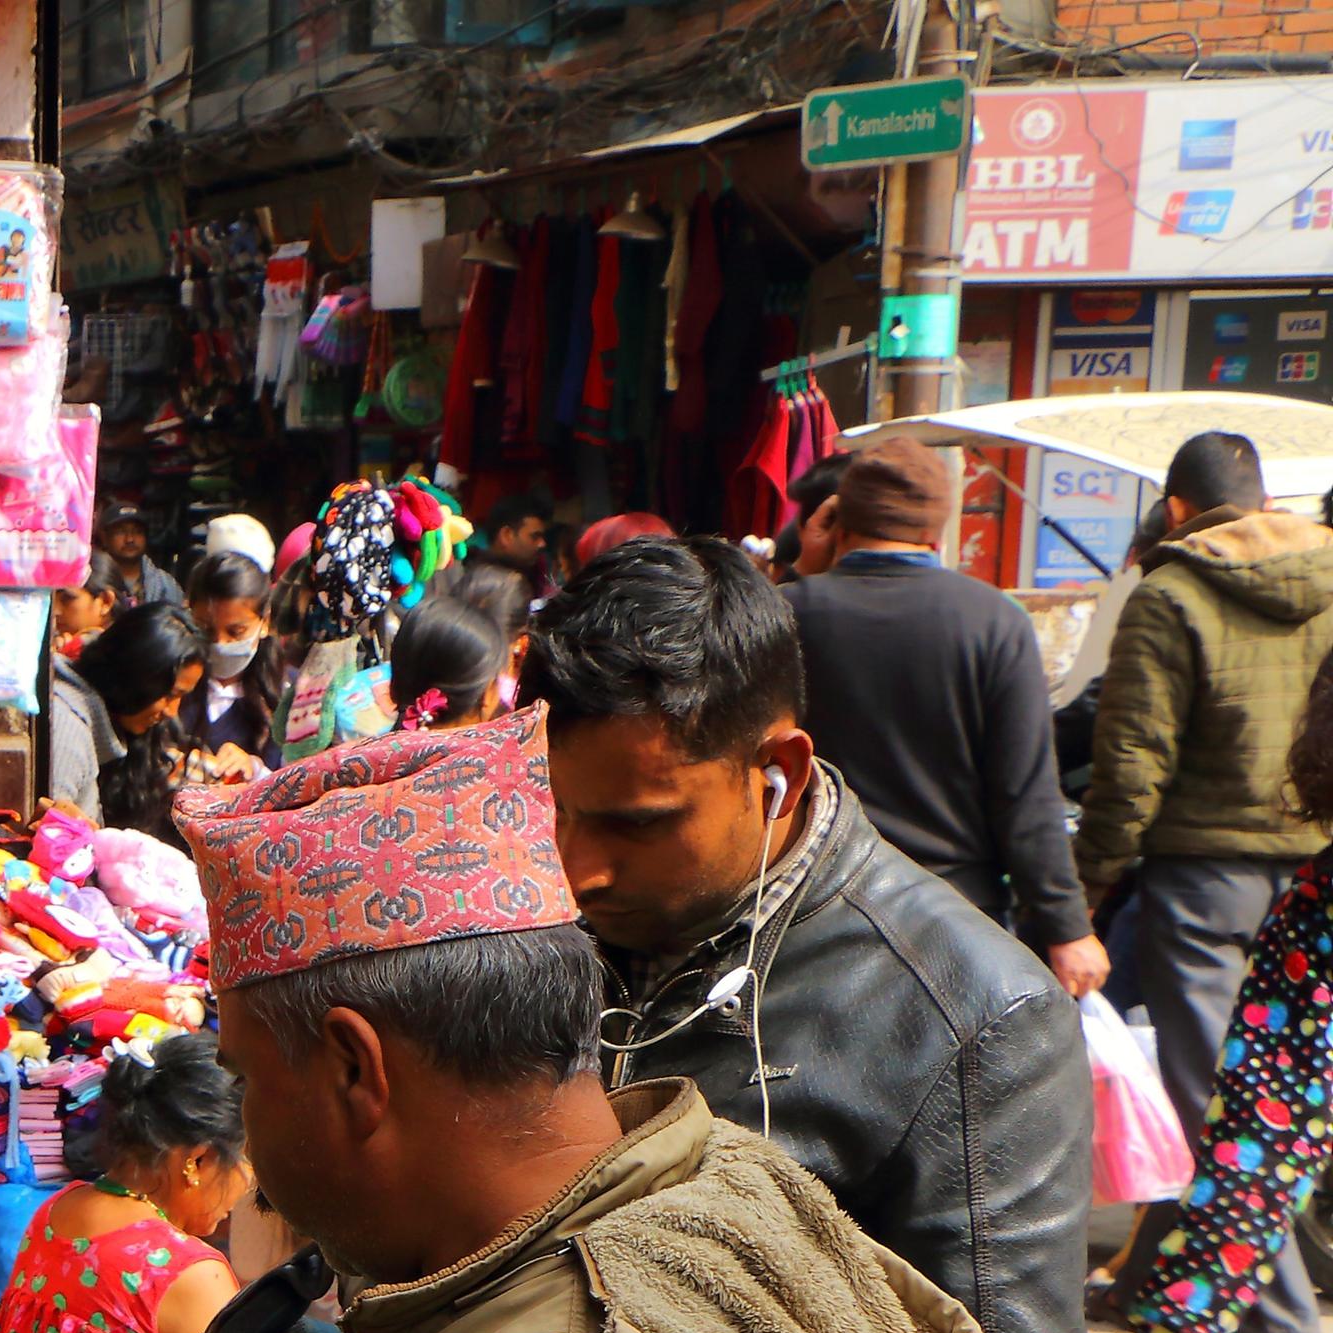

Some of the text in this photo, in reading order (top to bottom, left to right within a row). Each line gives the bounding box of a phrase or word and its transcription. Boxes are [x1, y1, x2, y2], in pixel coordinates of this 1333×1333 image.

[847, 107, 936, 138] Kamalachhi
[972, 154, 1096, 191] HBL
[962, 217, 1091, 270] ATM
[1285, 318, 1322, 332] VISA
[1070, 352, 1133, 377] VISA
[1052, 469, 1123, 496] SCT
